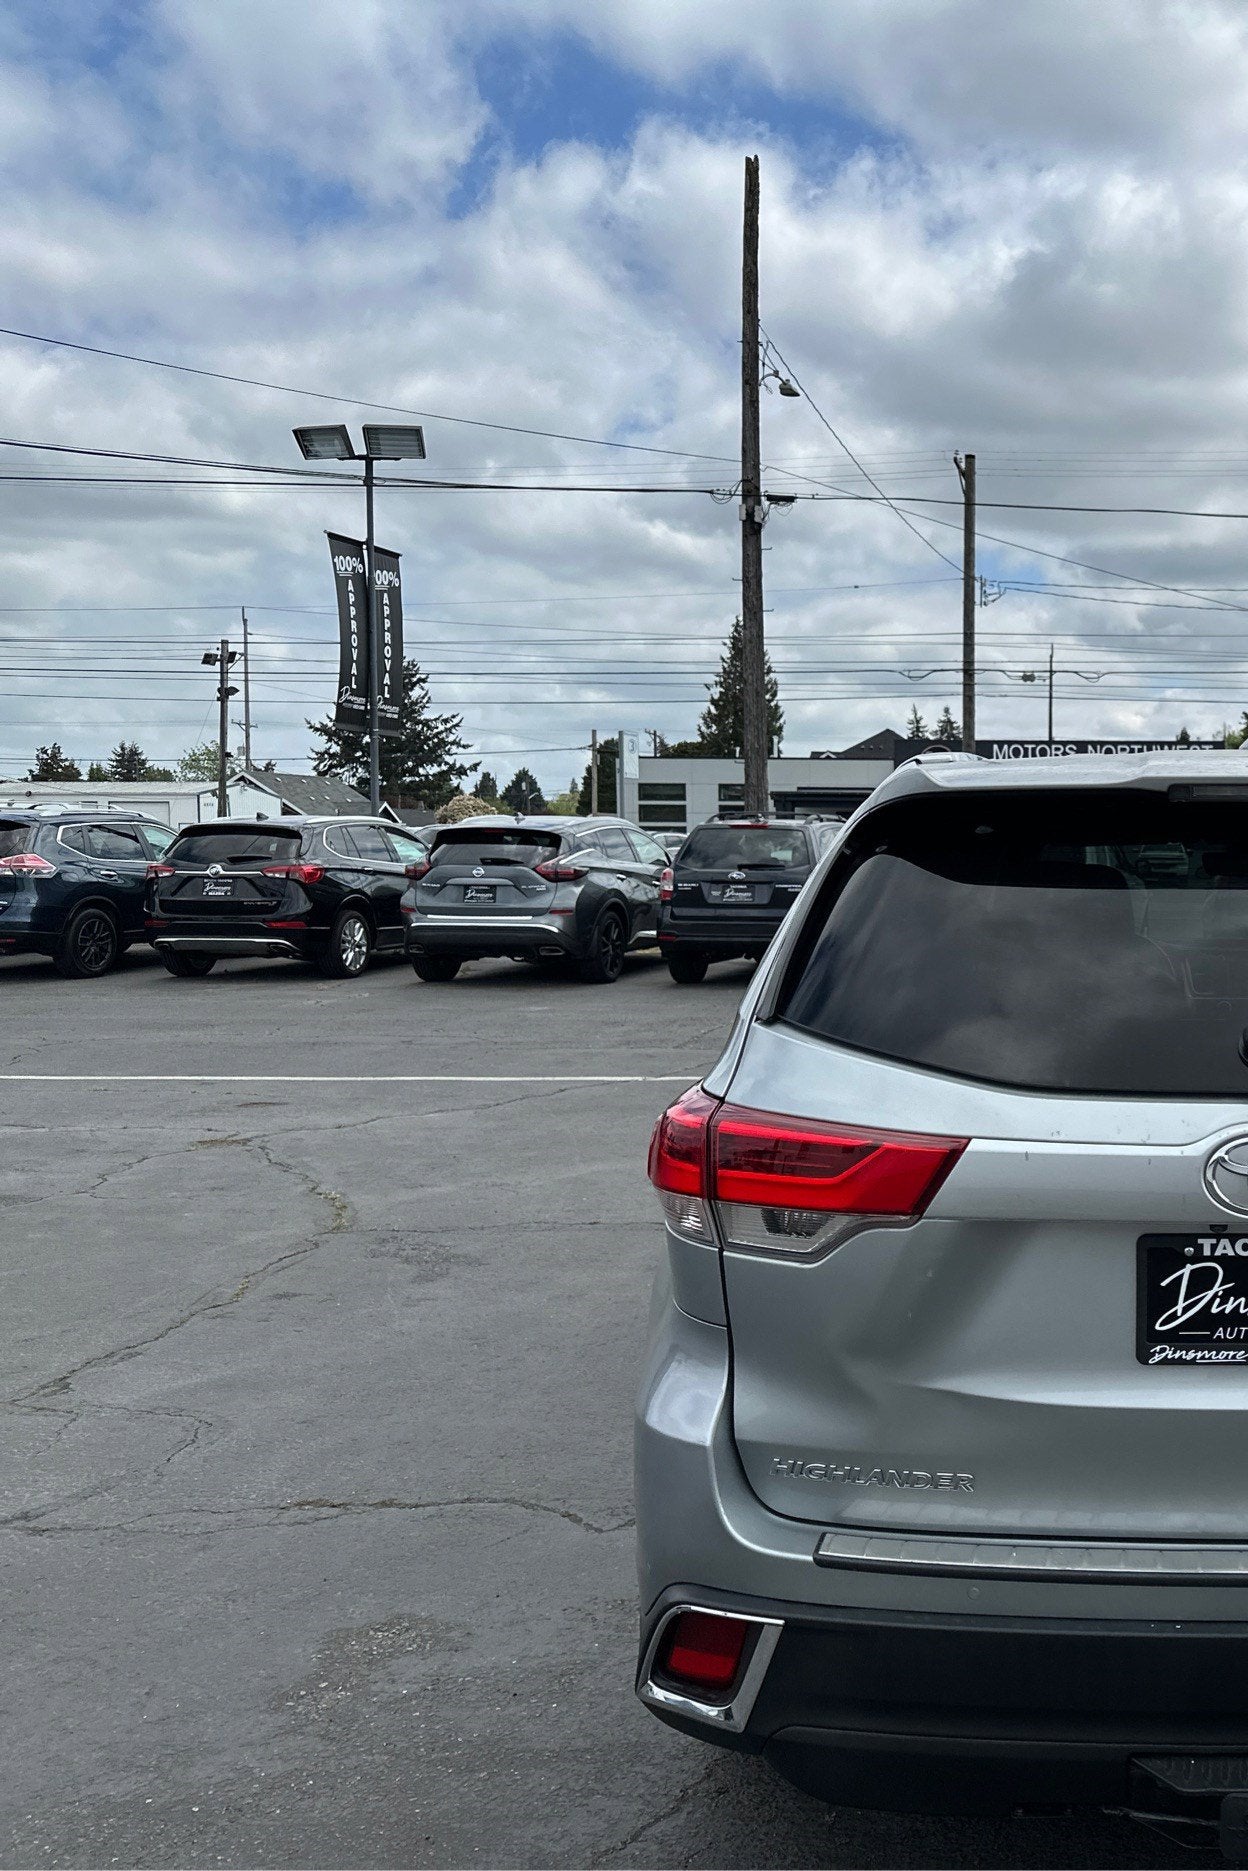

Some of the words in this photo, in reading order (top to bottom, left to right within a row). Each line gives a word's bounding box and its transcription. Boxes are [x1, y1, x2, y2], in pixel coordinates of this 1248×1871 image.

[333, 555, 364, 574] 100%
[374, 569, 400, 587] 00%
[347, 579, 358, 689] APPROVAL
[382, 592, 392, 698] APPROVAL
[992, 744, 1078, 760] MOTORS
[770, 1457, 974, 1493] HIGHLANDER
